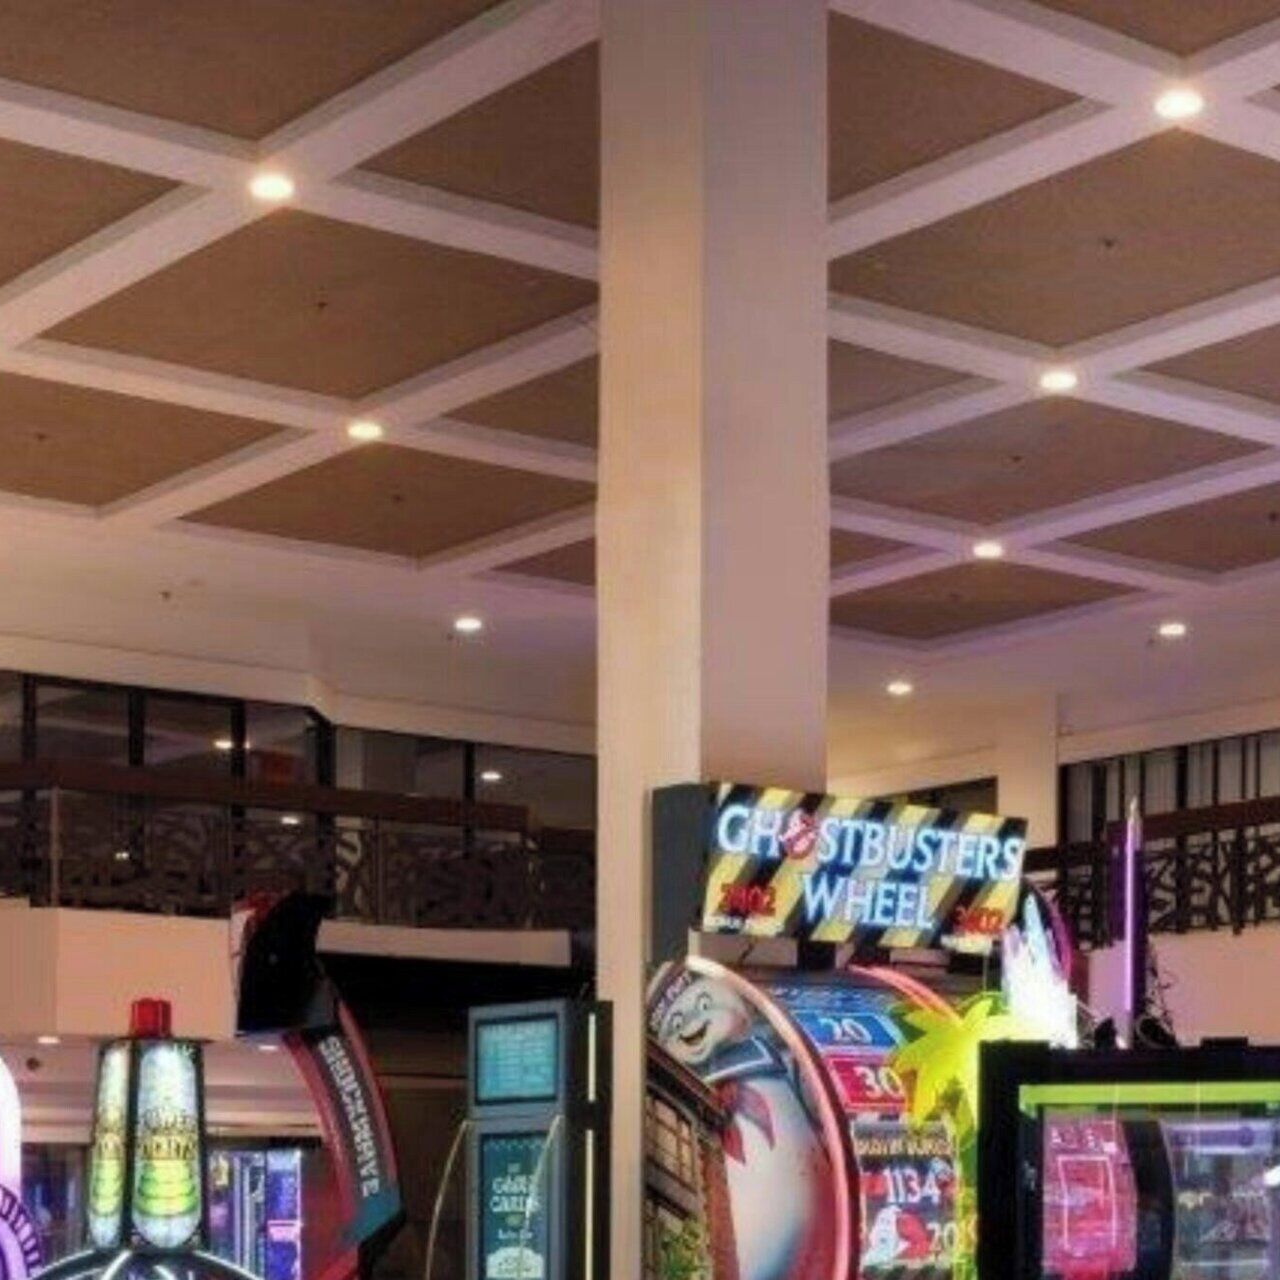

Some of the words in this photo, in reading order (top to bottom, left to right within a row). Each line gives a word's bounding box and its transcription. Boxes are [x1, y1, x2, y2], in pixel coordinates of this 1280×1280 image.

[802, 872, 933, 929] WHEEL
[853, 1066, 905, 1098] 30
[318, 1036, 380, 1198] SHOCKWAVE
